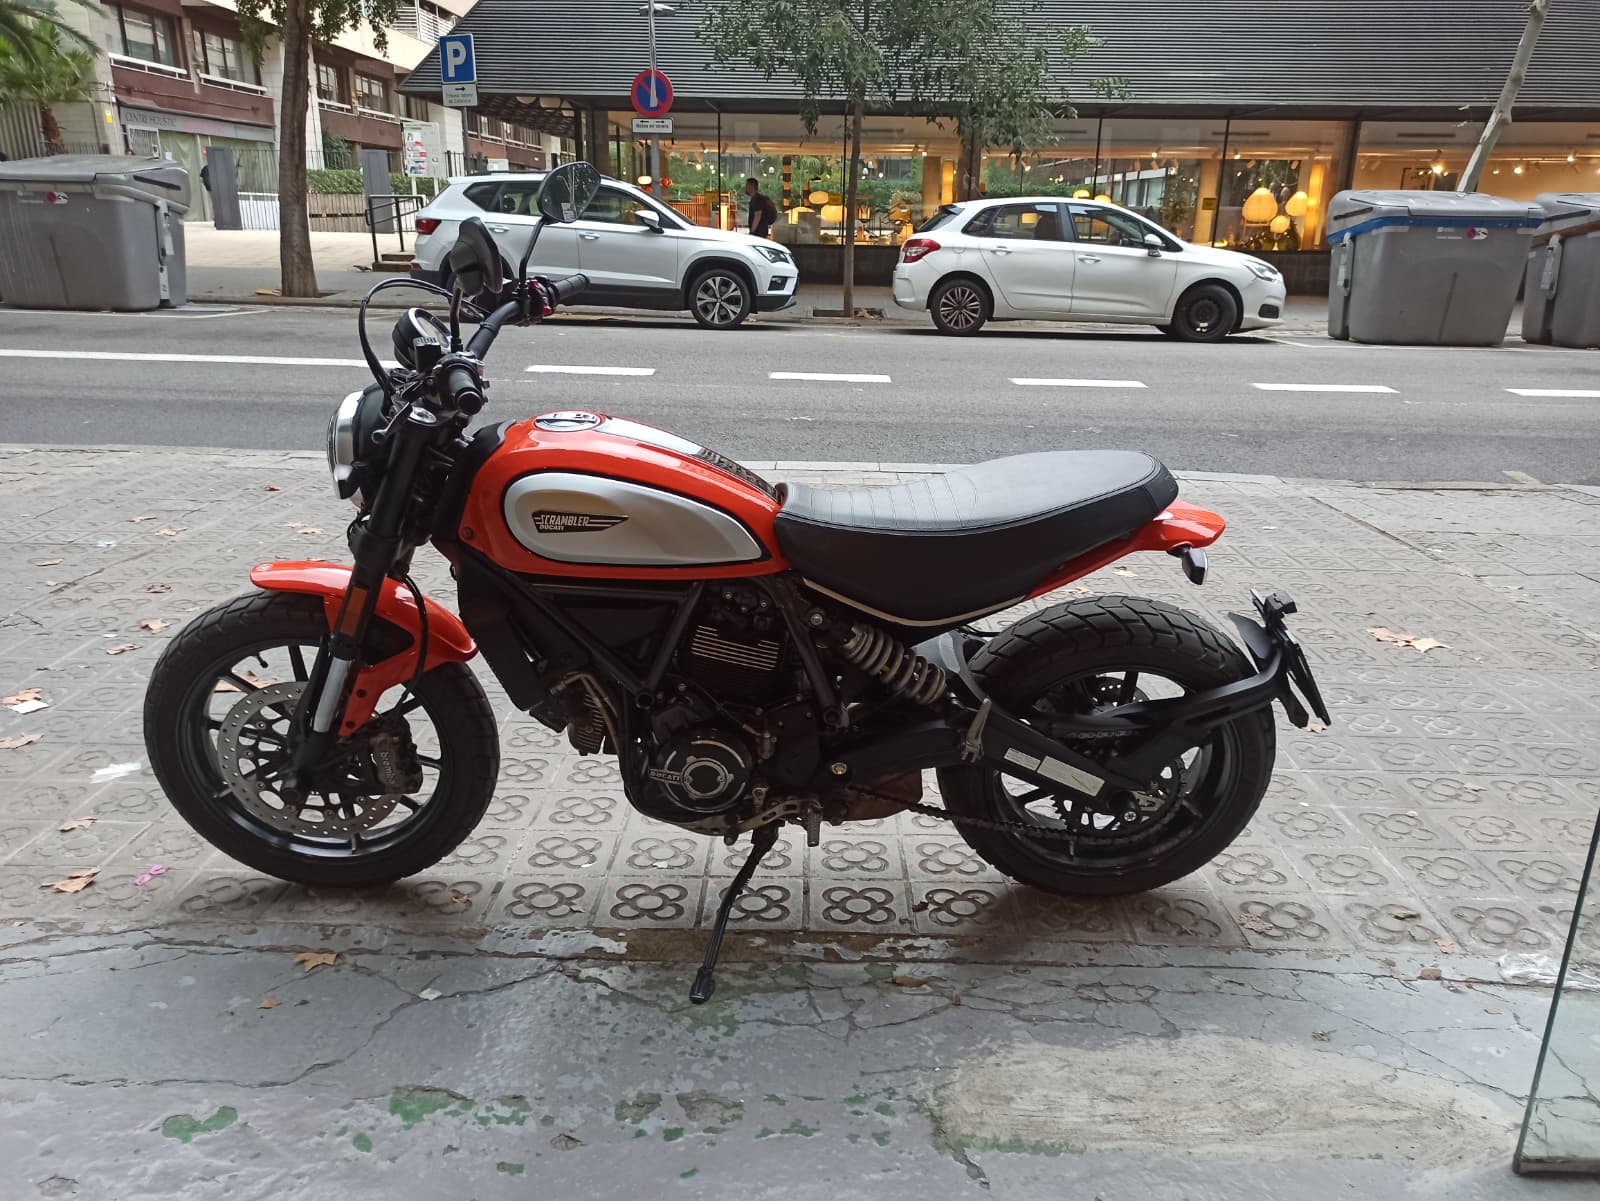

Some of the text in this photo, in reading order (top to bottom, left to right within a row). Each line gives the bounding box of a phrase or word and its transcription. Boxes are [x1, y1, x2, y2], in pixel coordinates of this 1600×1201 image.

[446, 41, 466, 77] P
[541, 514, 590, 527] SCRAMBLER
[650, 771, 680, 781] DUCATI
